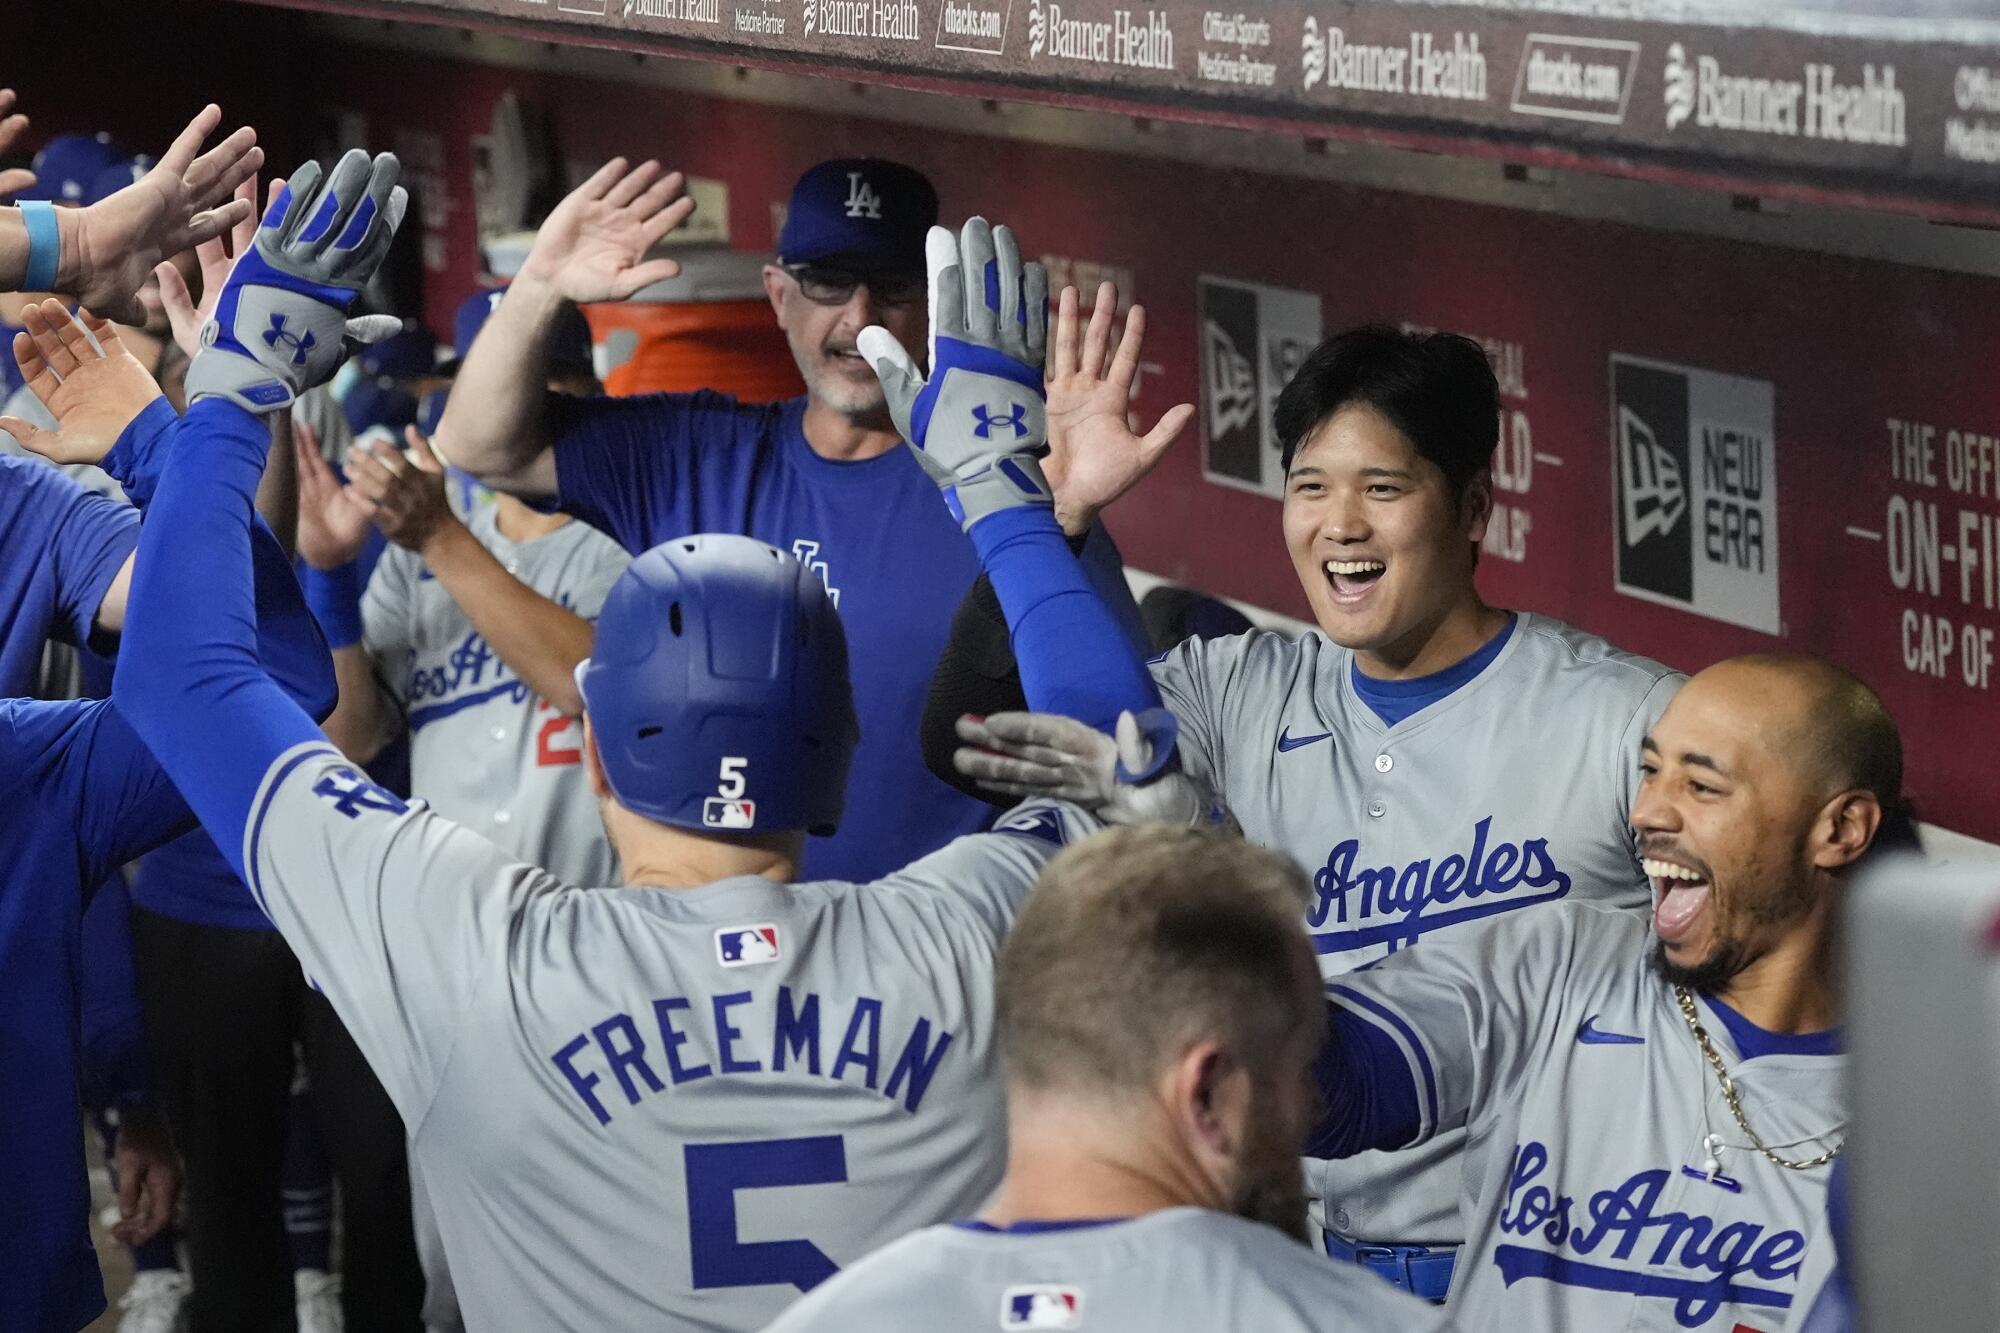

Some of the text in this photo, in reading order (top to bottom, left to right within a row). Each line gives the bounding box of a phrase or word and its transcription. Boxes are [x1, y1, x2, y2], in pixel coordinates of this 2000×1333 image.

[735, 8, 785, 35] Medicine Partner
[819, 0, 919, 40] Banner Health
[945, 1, 1000, 38] dbacks.com
[1048, 4, 1174, 69] Banner Health
[1327, 27, 1487, 100] Banner Health
[1697, 55, 1801, 135] Banner
[1803, 62, 1906, 146] Health
[844, 172, 882, 219] LA
[1703, 428, 1762, 501] NEW
[1886, 418, 1937, 487] THE
[1705, 498, 1764, 574] ERA
[1887, 495, 2000, 612] ON-FI
[1902, 608, 1994, 690] CAP OF
[718, 757, 748, 800] 5
[1306, 815, 1560, 954] Angeles
[551, 985, 953, 1127] FREEMAN
[683, 1134, 848, 1294] 5
[1501, 1141, 1574, 1246] Los
